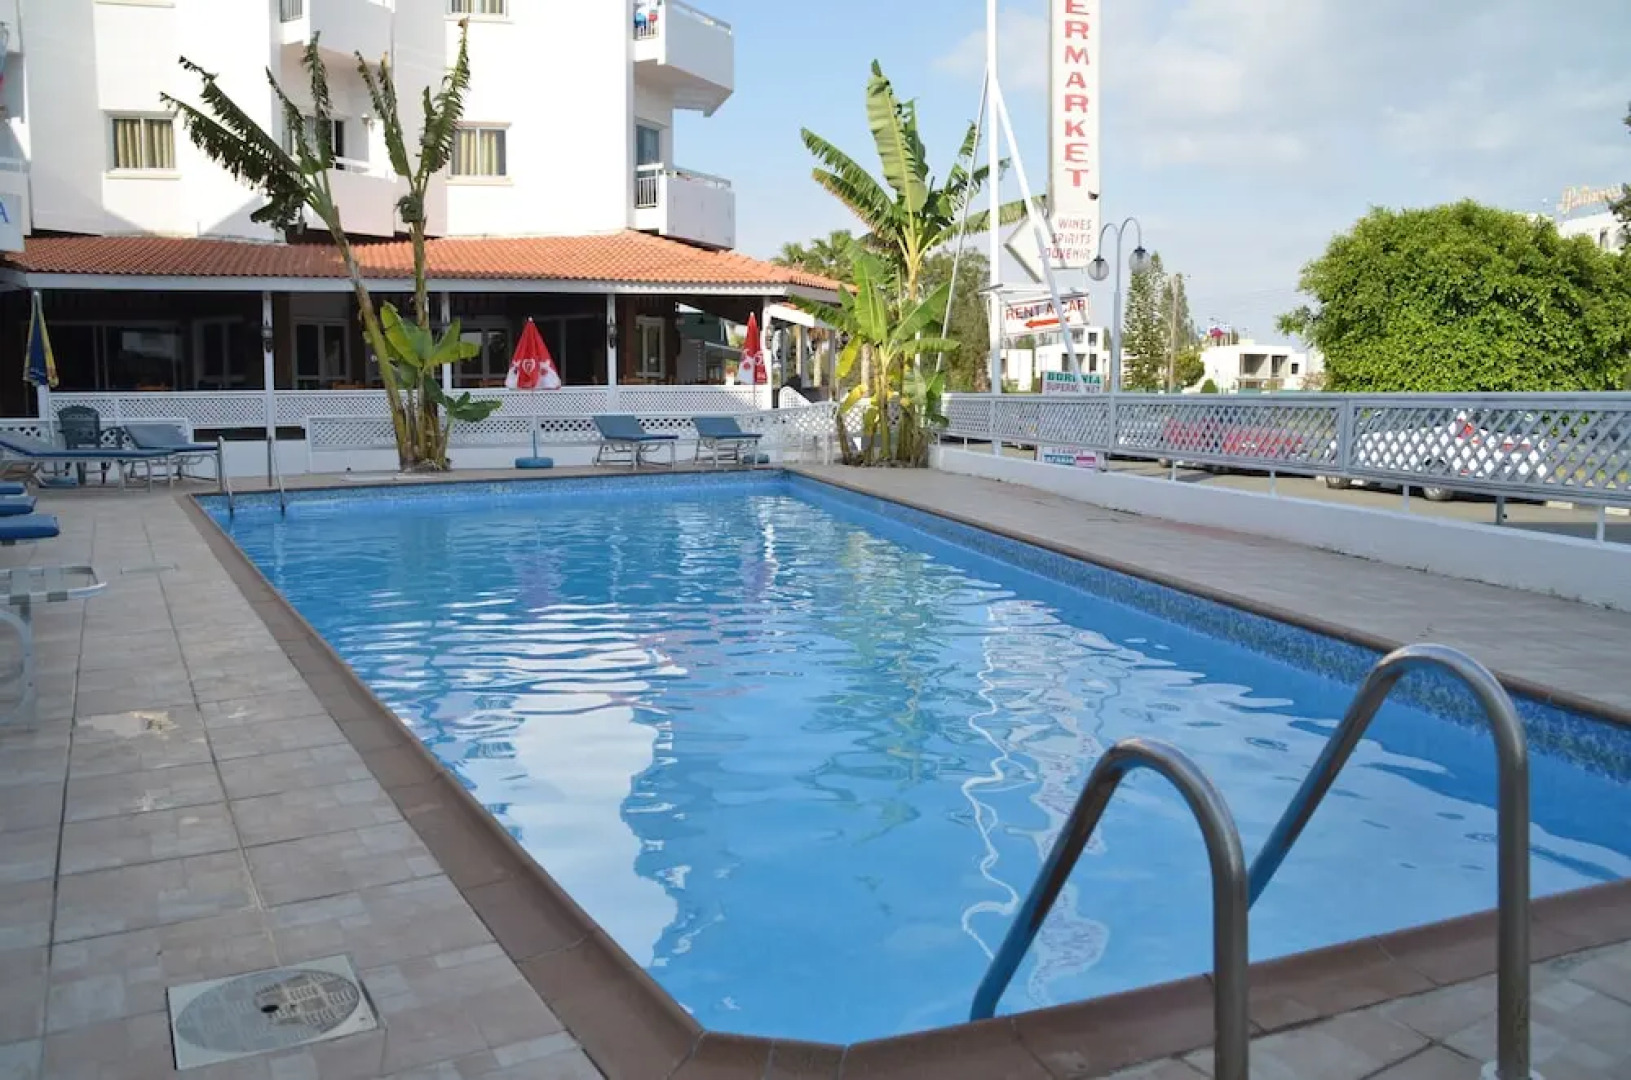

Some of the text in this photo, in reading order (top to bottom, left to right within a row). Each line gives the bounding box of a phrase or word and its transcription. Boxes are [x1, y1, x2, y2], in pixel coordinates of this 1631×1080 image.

[1064, 0, 1090, 187] ERMARKET
[1058, 219, 1092, 230] WINES
[1005, 304, 1040, 321] RENT
